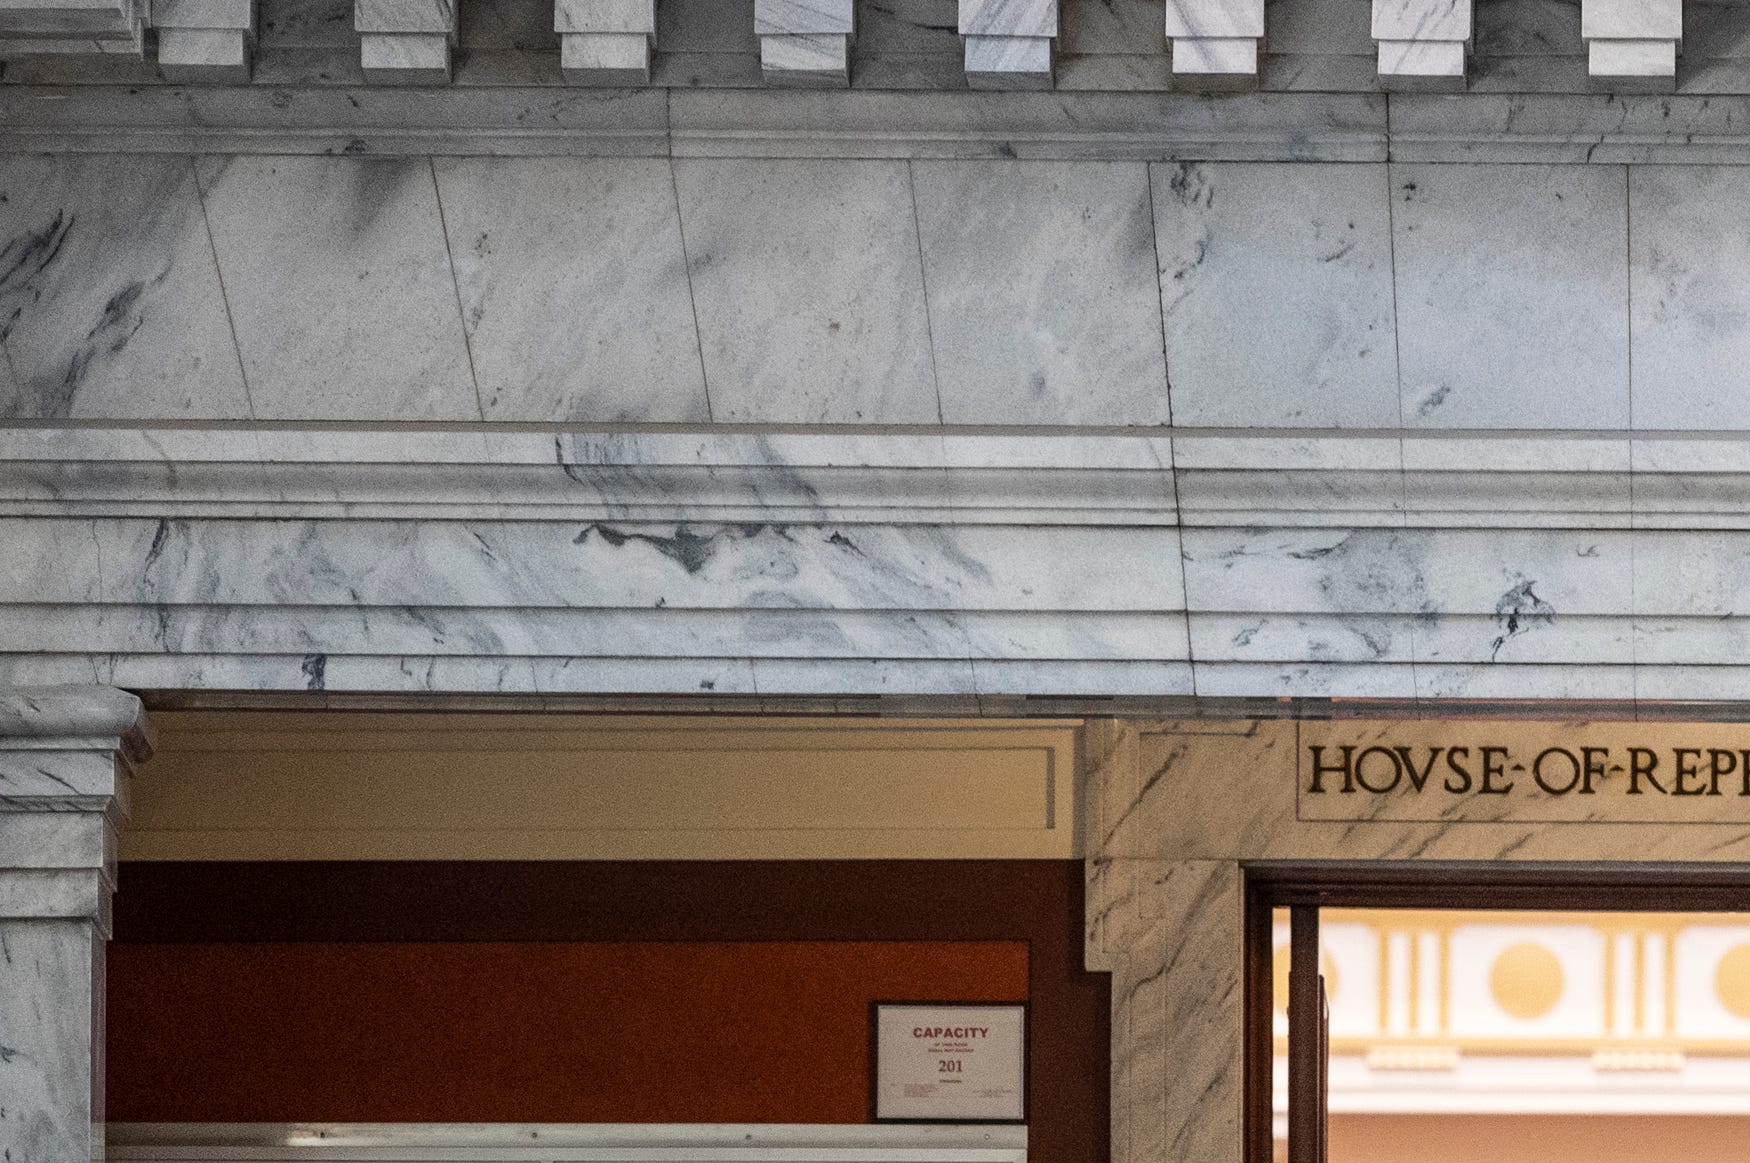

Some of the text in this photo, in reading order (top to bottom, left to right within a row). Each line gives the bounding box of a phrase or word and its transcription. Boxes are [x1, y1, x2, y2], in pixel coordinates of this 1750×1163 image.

[1532, 746, 1609, 796] OF
[912, 1026, 989, 1039] CAPACITY
[938, 1060, 964, 1073] 201
